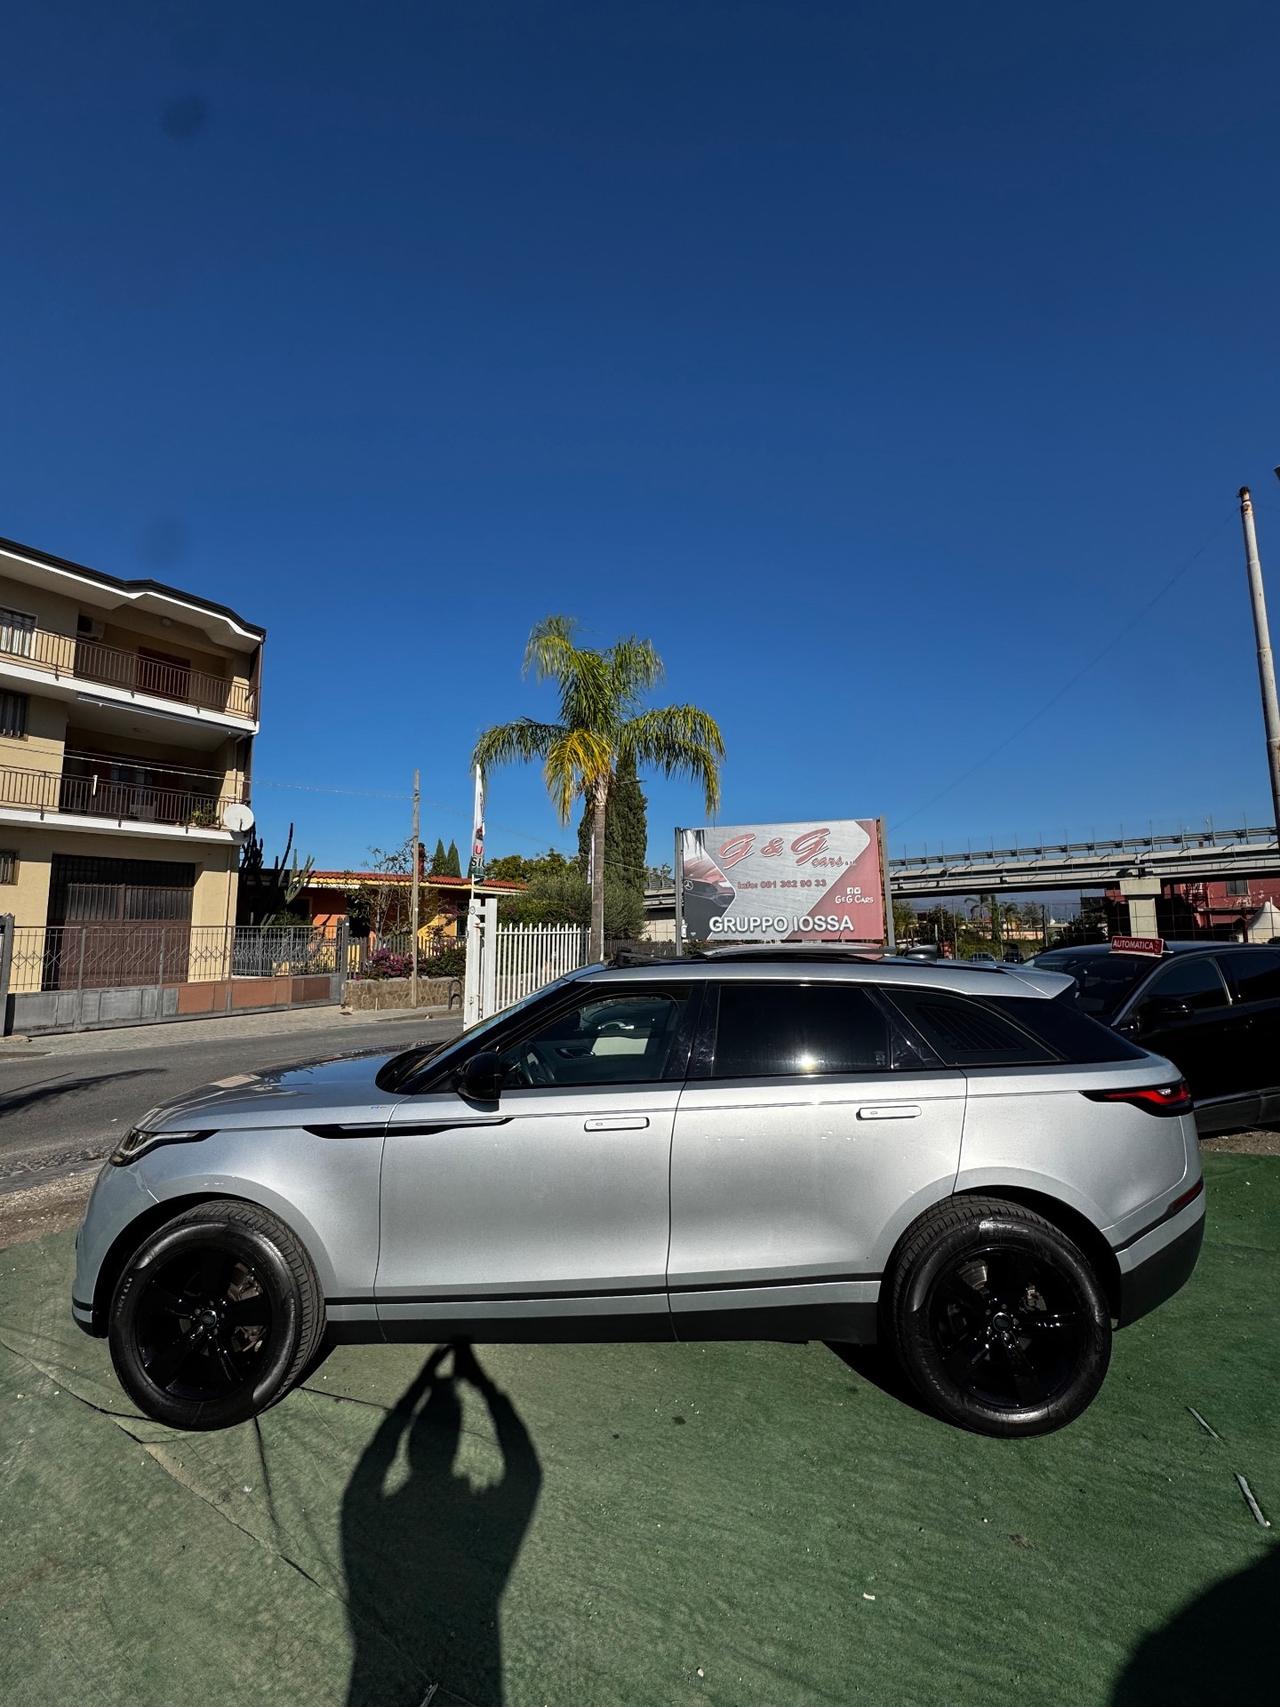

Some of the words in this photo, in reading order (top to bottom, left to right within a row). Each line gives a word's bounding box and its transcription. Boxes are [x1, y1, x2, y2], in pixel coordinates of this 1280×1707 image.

[760, 836, 784, 857] &
[709, 916, 789, 933] GRUPPO
[793, 915, 854, 932] IOSSA
[1113, 940, 1154, 950] AUTOMATICA
